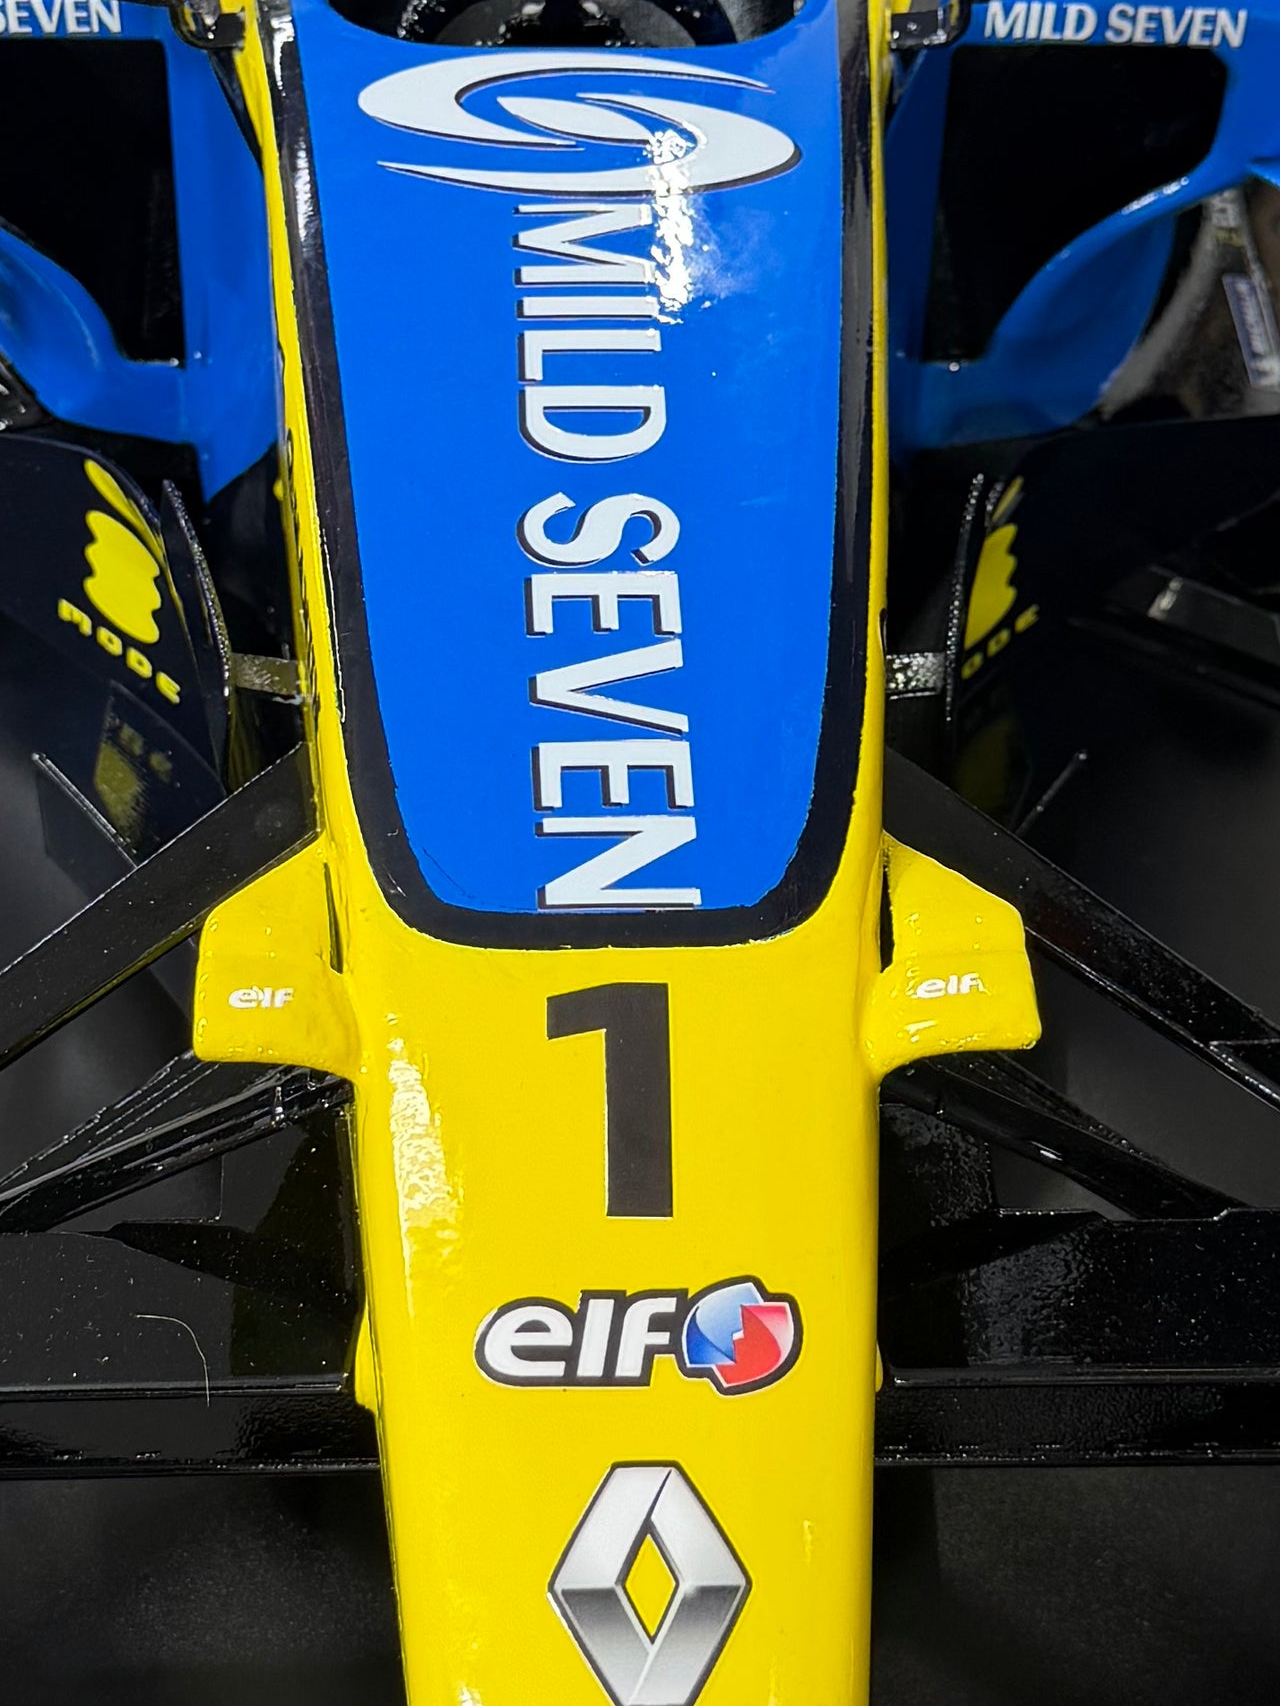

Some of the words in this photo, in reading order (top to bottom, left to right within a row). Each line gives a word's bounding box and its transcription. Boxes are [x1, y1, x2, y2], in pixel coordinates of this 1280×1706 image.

[983, 0, 1098, 43] MILD
[1104, 5, 1249, 49] SEVEN
[512, 203, 668, 464] MILD
[517, 491, 702, 913] SEVEN
[545, 981, 674, 1219] 1
